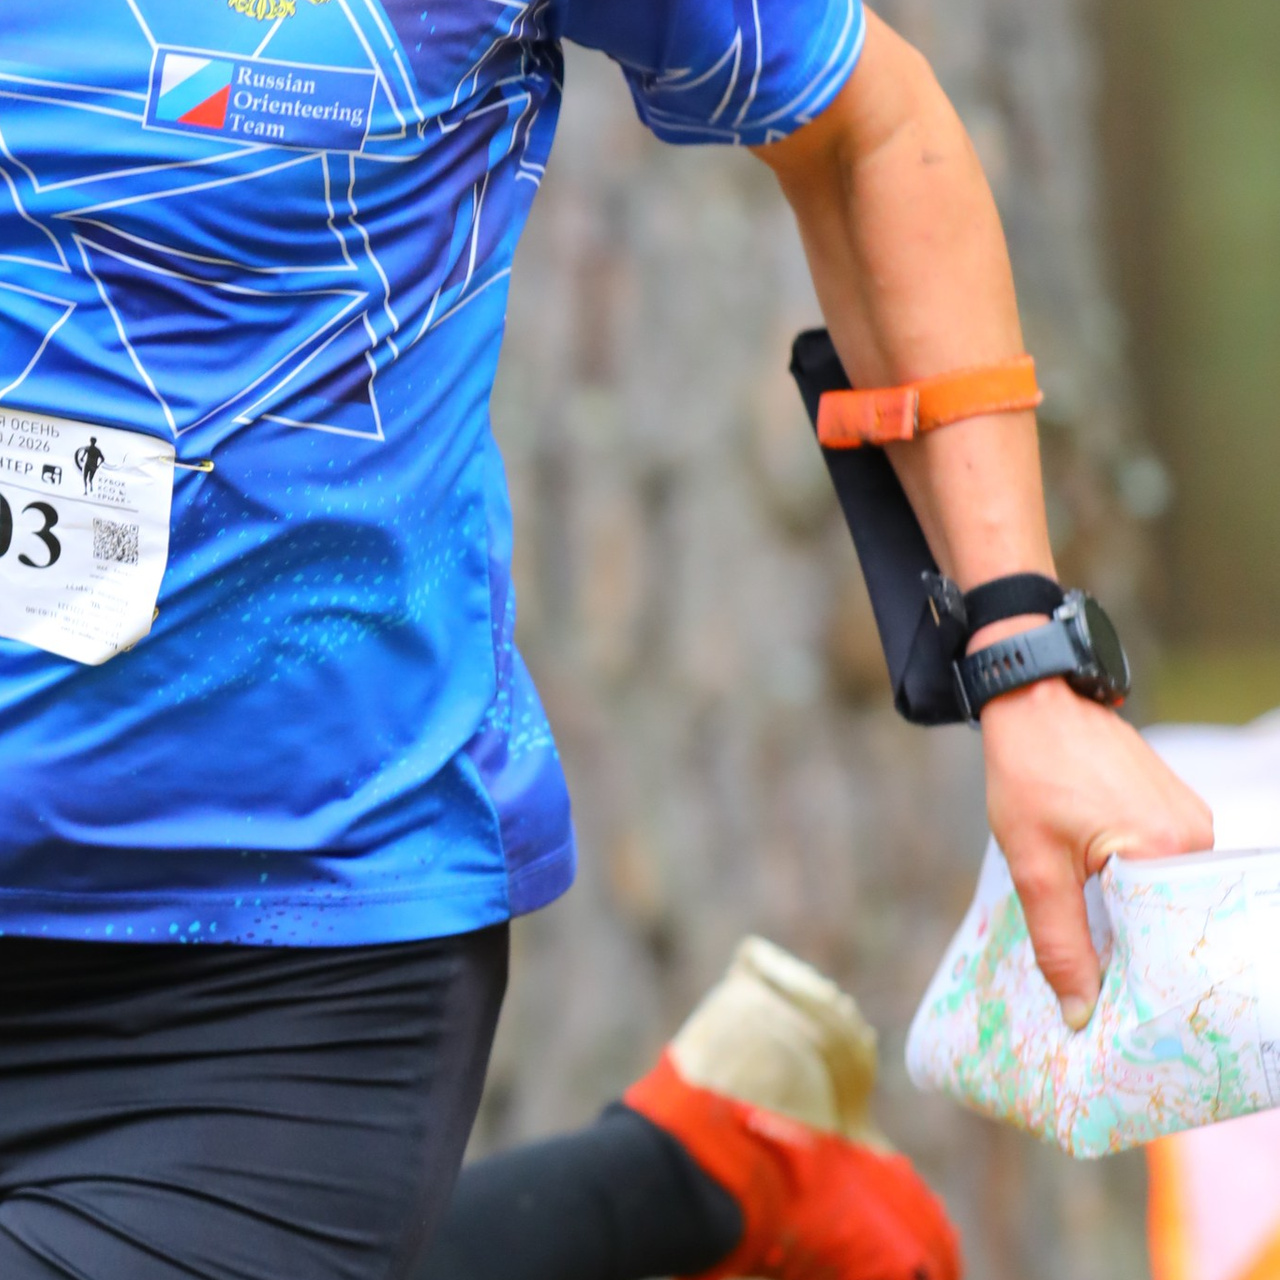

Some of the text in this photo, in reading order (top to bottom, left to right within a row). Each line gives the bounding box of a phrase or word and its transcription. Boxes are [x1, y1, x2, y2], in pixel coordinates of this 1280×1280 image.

[236, 66, 316, 94] Russian
[233, 91, 364, 126] Orienteering
[229, 113, 285, 139] Team
[11, 418, 60, 438] ОСЕНЬ
[18, 436, 51, 453] 2026
